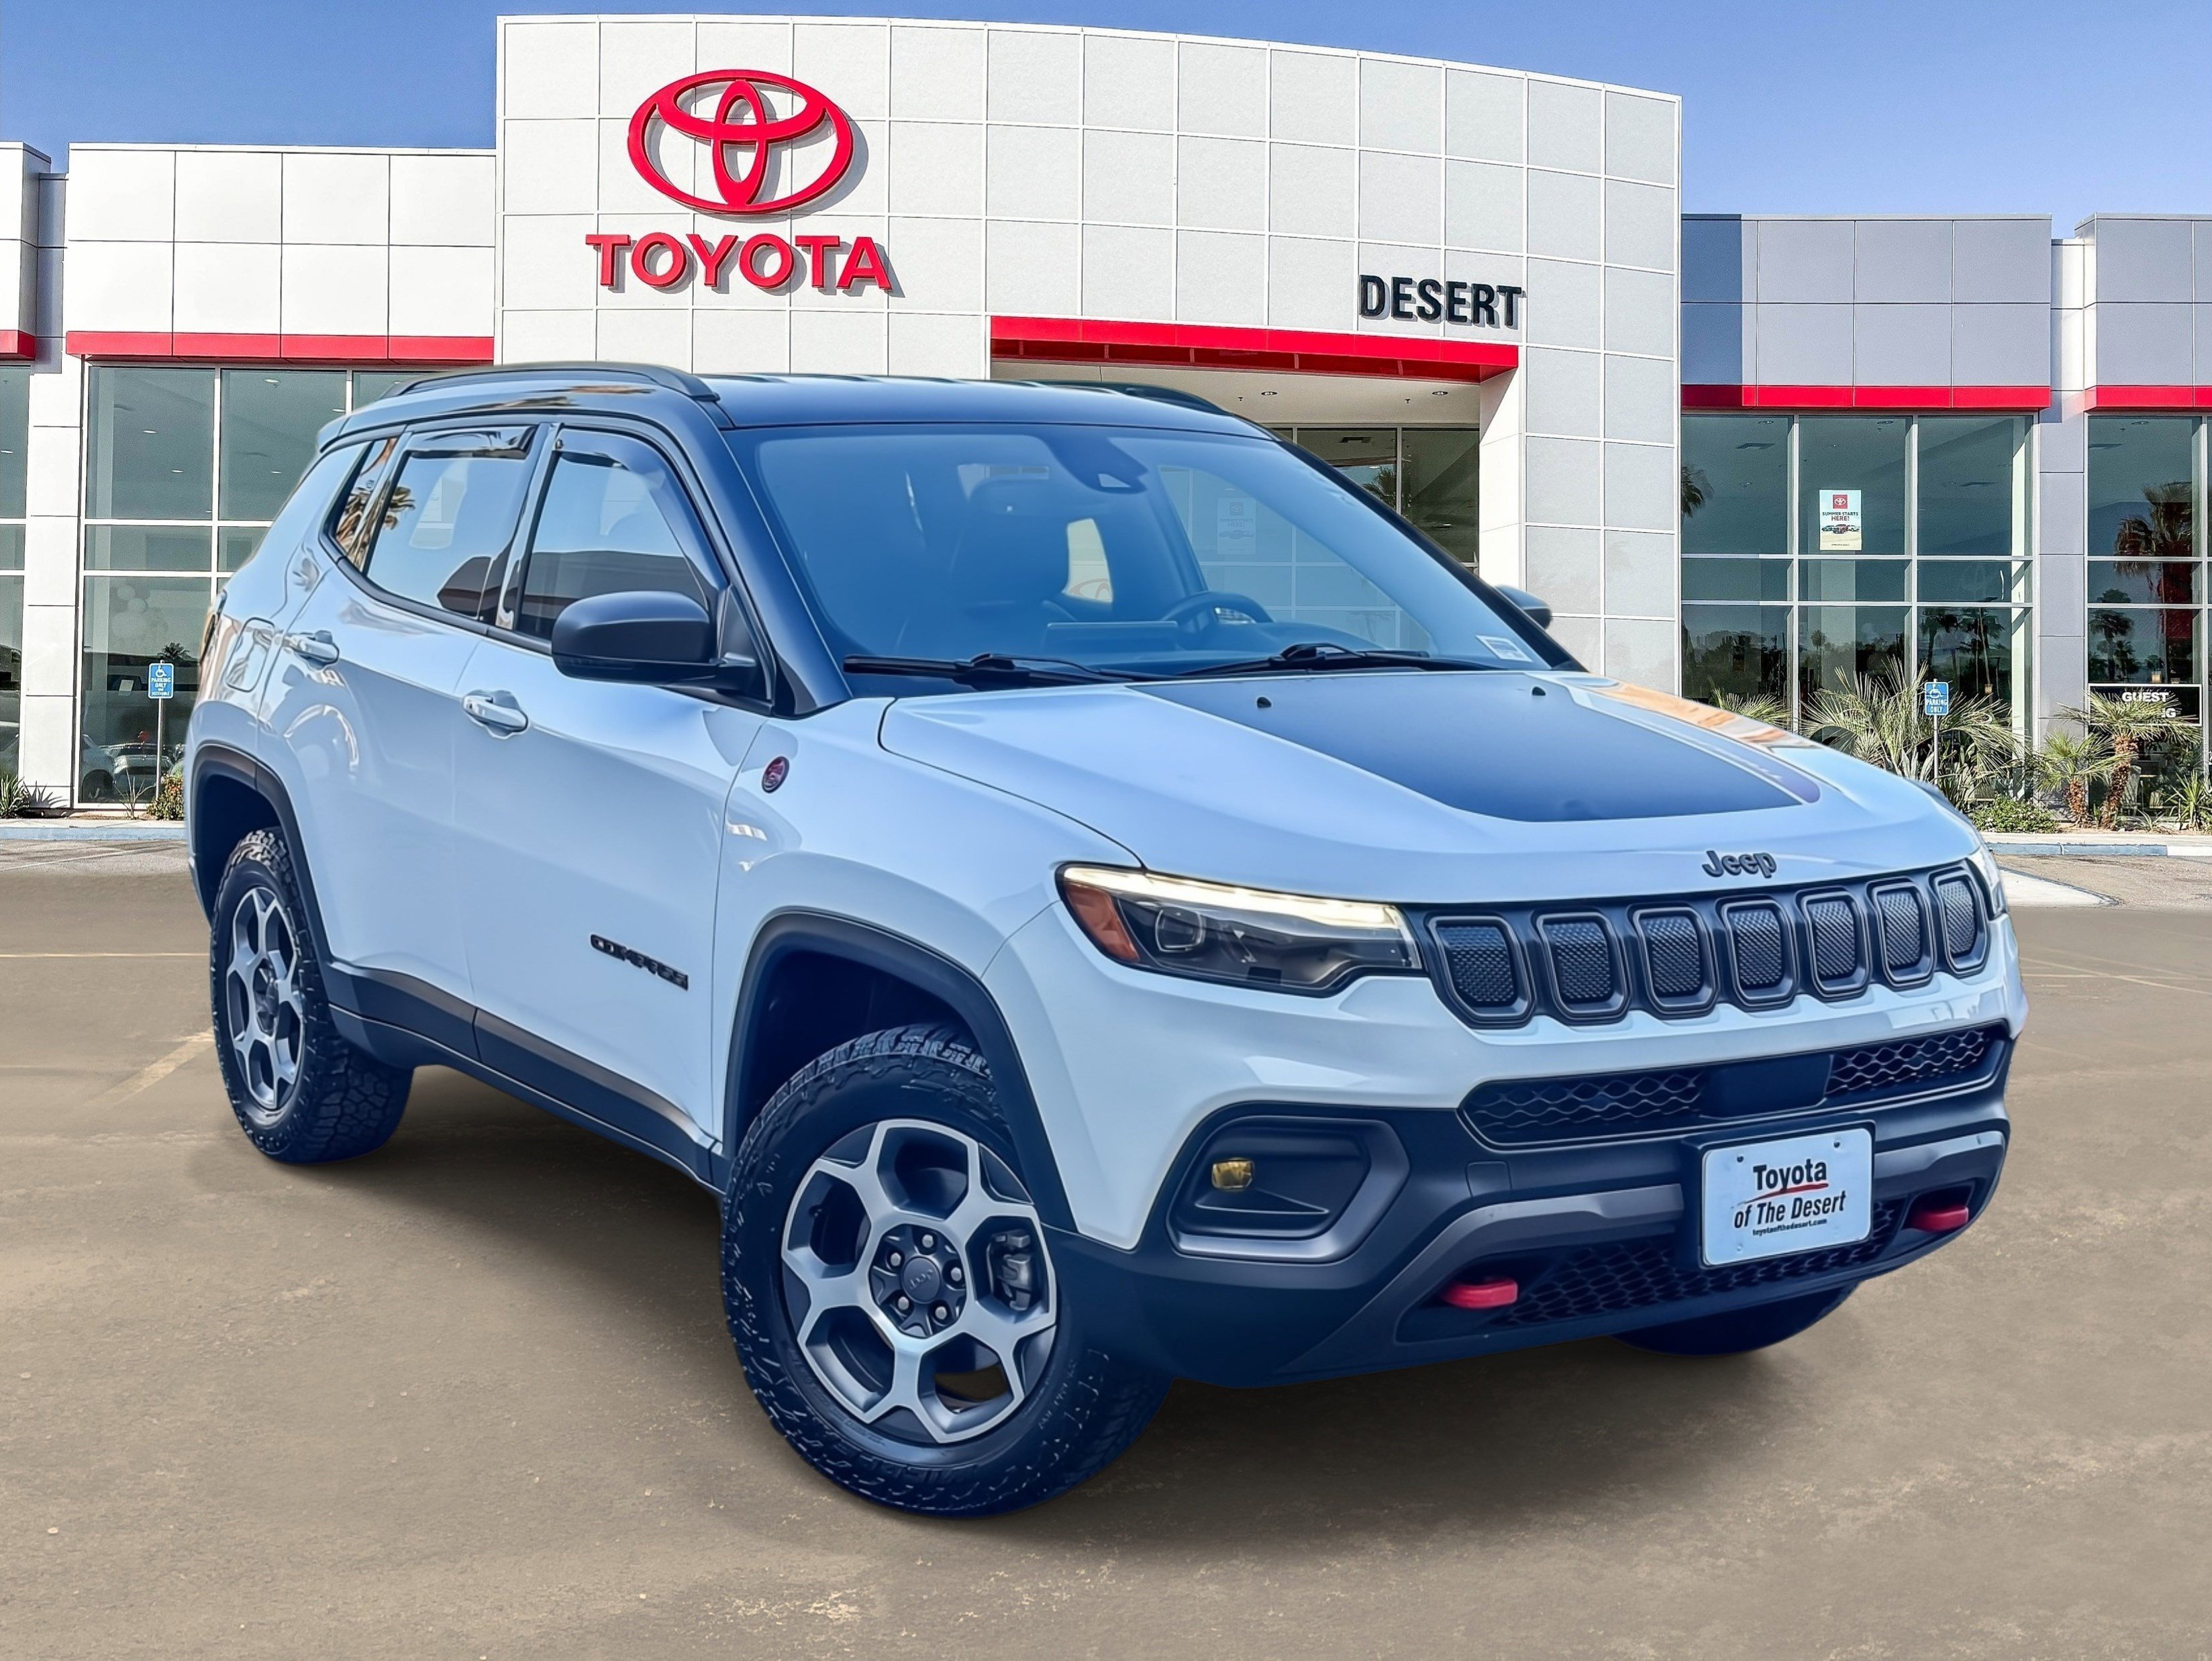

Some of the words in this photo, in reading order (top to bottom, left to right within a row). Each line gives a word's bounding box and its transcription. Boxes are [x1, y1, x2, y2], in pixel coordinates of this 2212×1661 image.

[585, 232, 892, 290] TOYOTA
[1359, 274, 1522, 326] DESERT
[2122, 692, 2169, 703] GUEST
[1701, 850, 1777, 879] Jeep
[1752, 1158, 1827, 1193] Toyota
[1734, 1204, 1752, 1229] of
[1757, 1201, 1786, 1225] The
[1791, 1190, 1846, 1219] Desert
[1752, 1219, 1827, 1236] toyotaofthedesert.com
